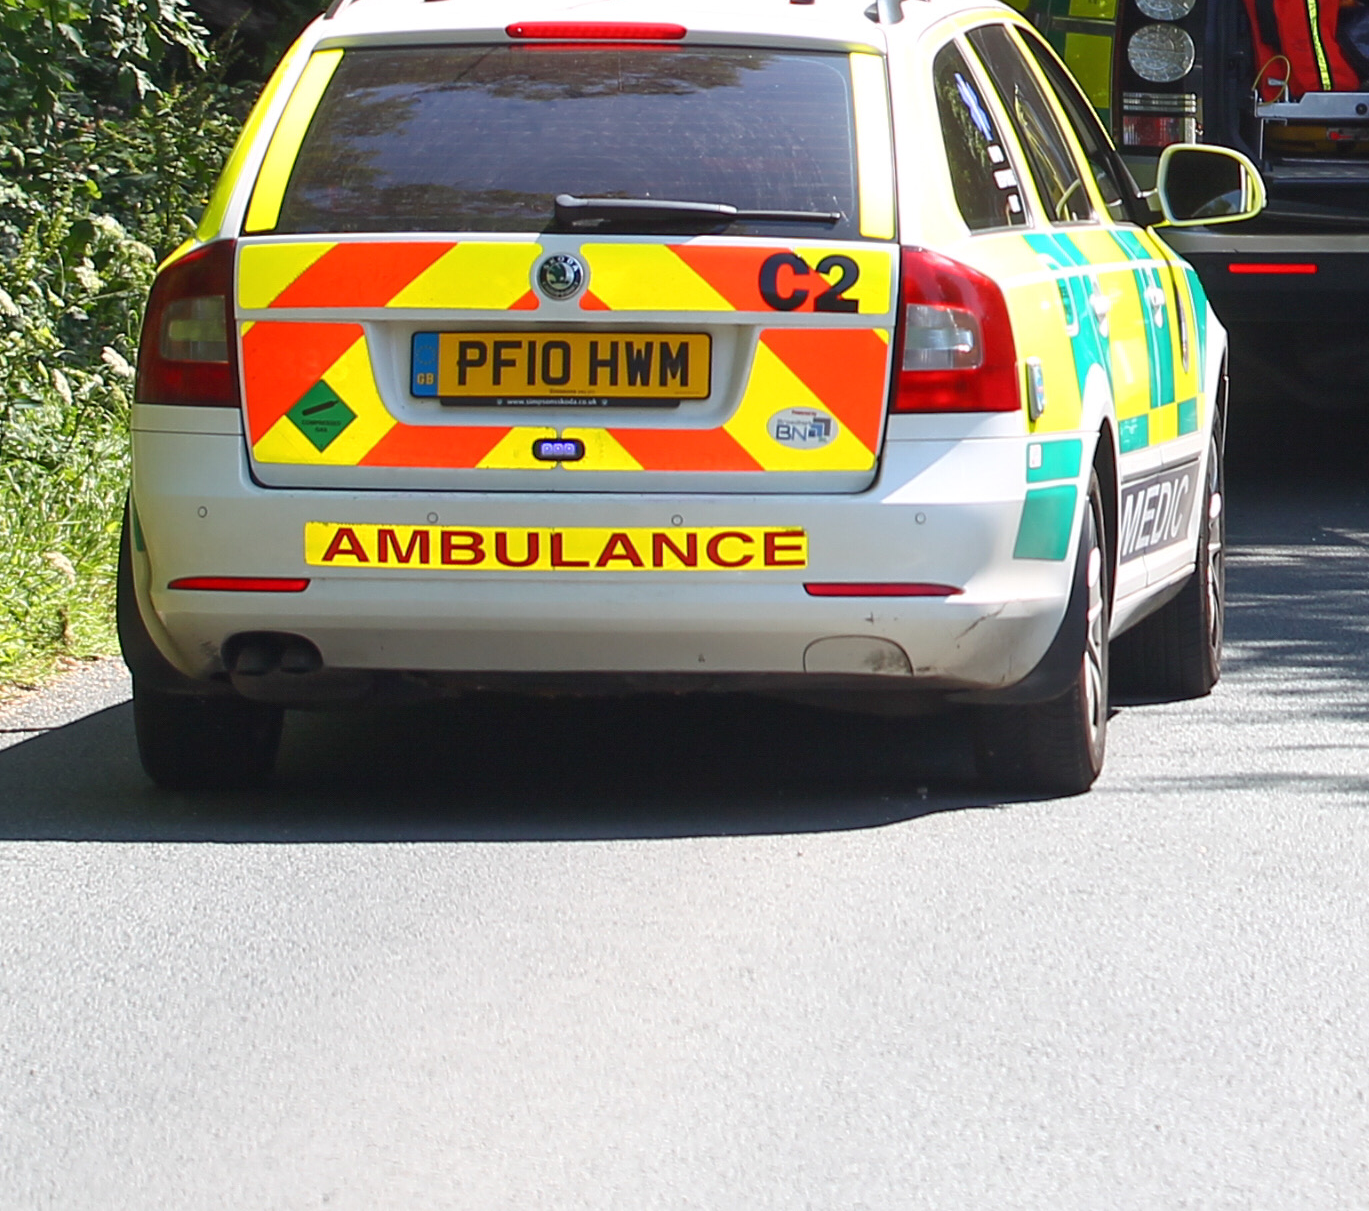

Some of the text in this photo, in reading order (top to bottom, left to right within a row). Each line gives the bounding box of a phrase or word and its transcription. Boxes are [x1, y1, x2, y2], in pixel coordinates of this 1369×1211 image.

[758, 252, 860, 313] C2
[417, 373, 434, 385] GB
[457, 340, 689, 387] PF10 HWM
[1121, 474, 1190, 557] MEDIC
[321, 527, 806, 568] AMBULANCE
